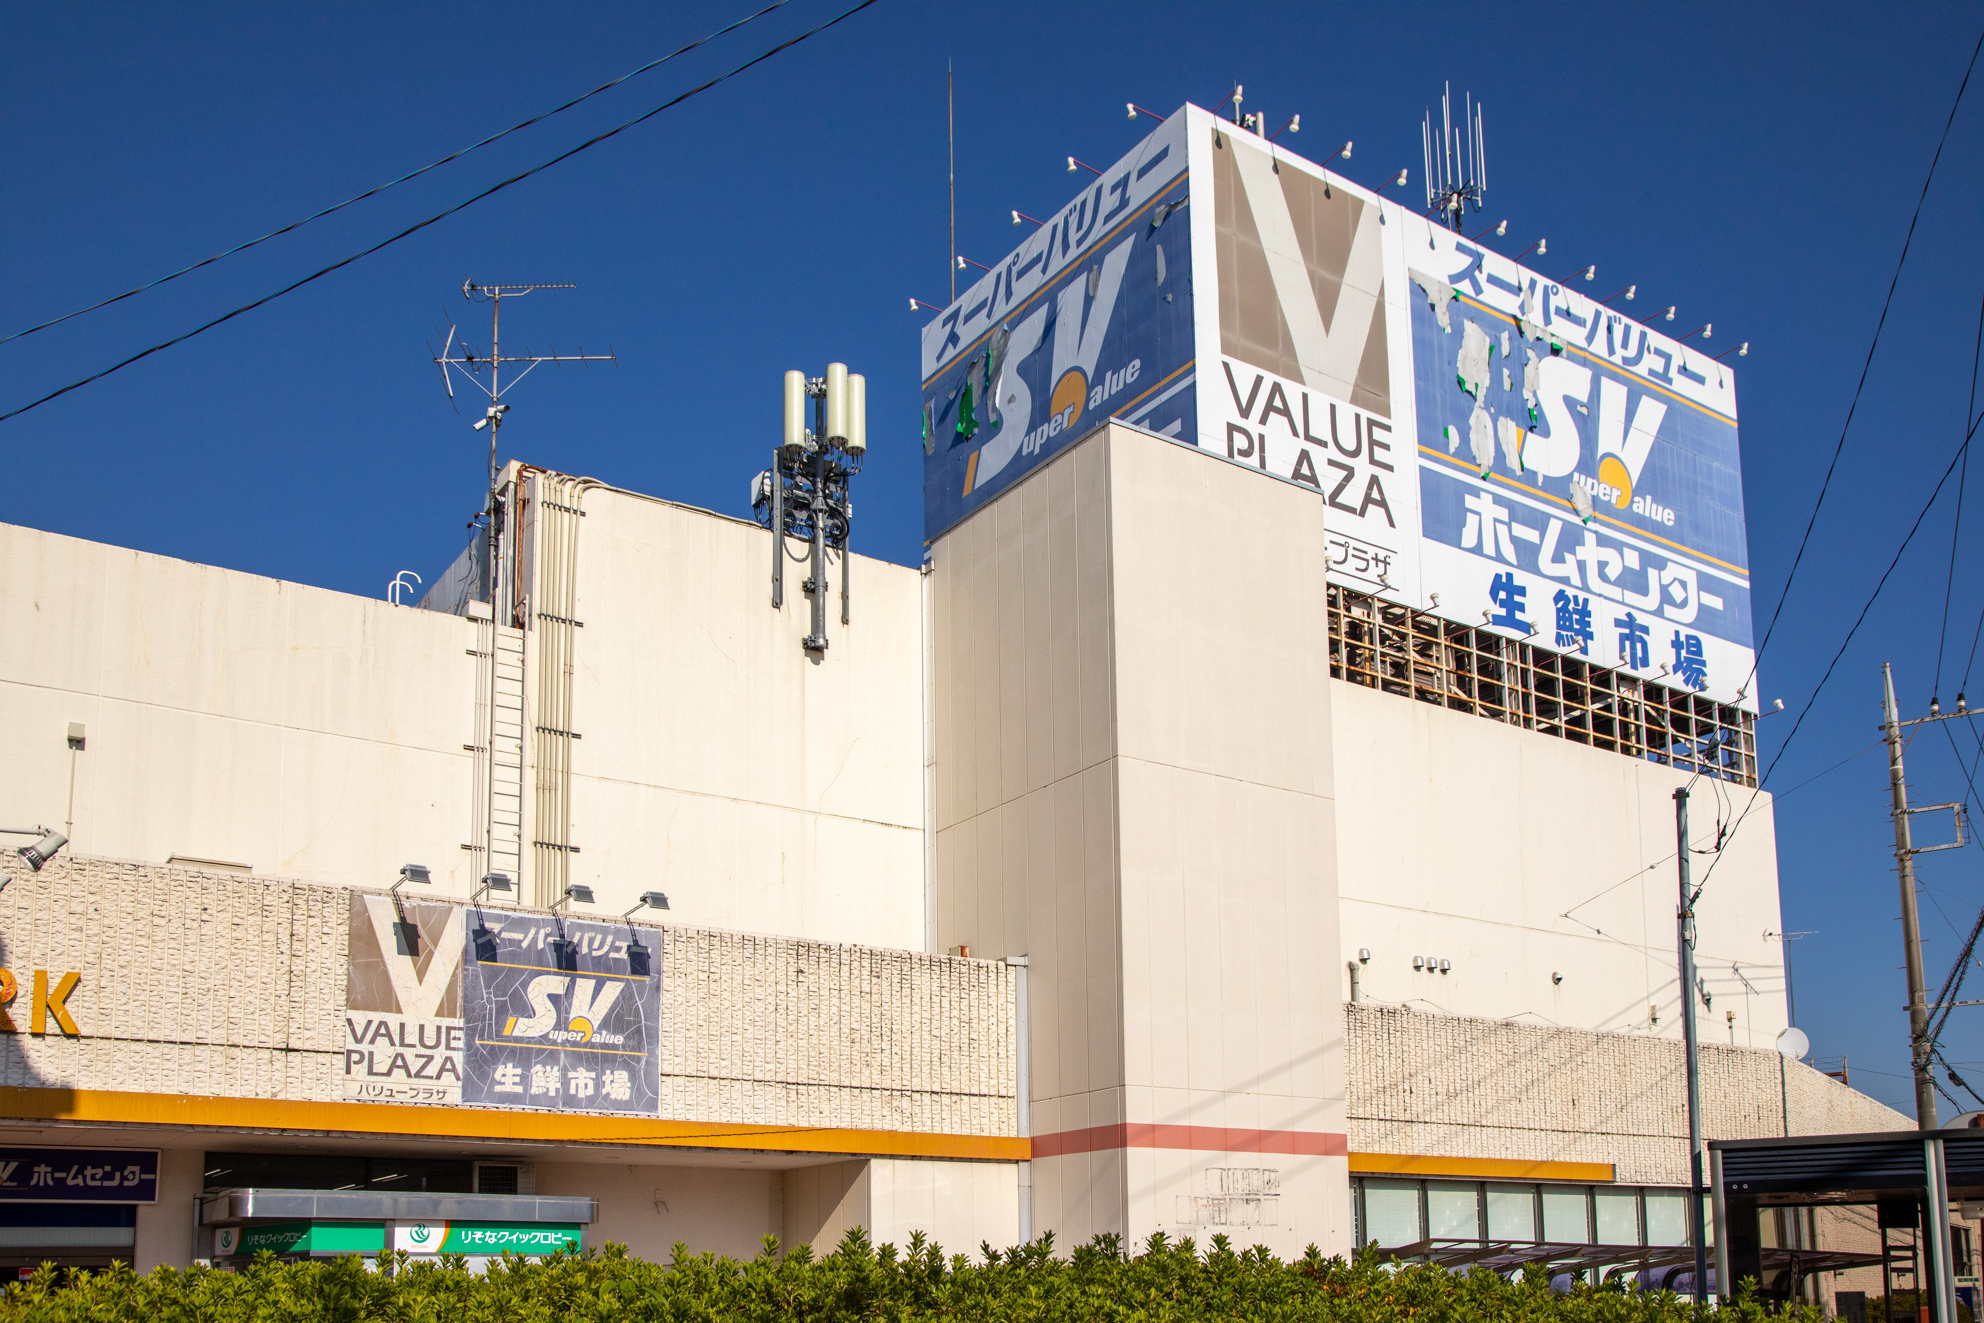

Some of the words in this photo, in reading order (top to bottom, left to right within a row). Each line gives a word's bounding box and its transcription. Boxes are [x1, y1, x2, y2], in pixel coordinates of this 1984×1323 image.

[936, 144, 1170, 363] スーパーバリュー
[1448, 241, 1706, 387] スーパーバリュー
[1221, 360, 1395, 474] VALUE
[1324, 538, 1392, 578] プラザ
[1461, 491, 1723, 624] ホームセンター
[1489, 571, 1708, 691] 生鮮市場
[346, 1018, 465, 1052] VALUE
[591, 1030, 625, 1046] alue
[345, 1048, 463, 1082] PLAZA
[493, 1062, 632, 1101] 生鮮市場
[357, 1083, 448, 1101] バリュープラザ
[30, 1163, 156, 1187] ホームセンター
[247, 1232, 307, 1246] りそなクイックロビー
[461, 1230, 572, 1245] りそなクイックロビー
